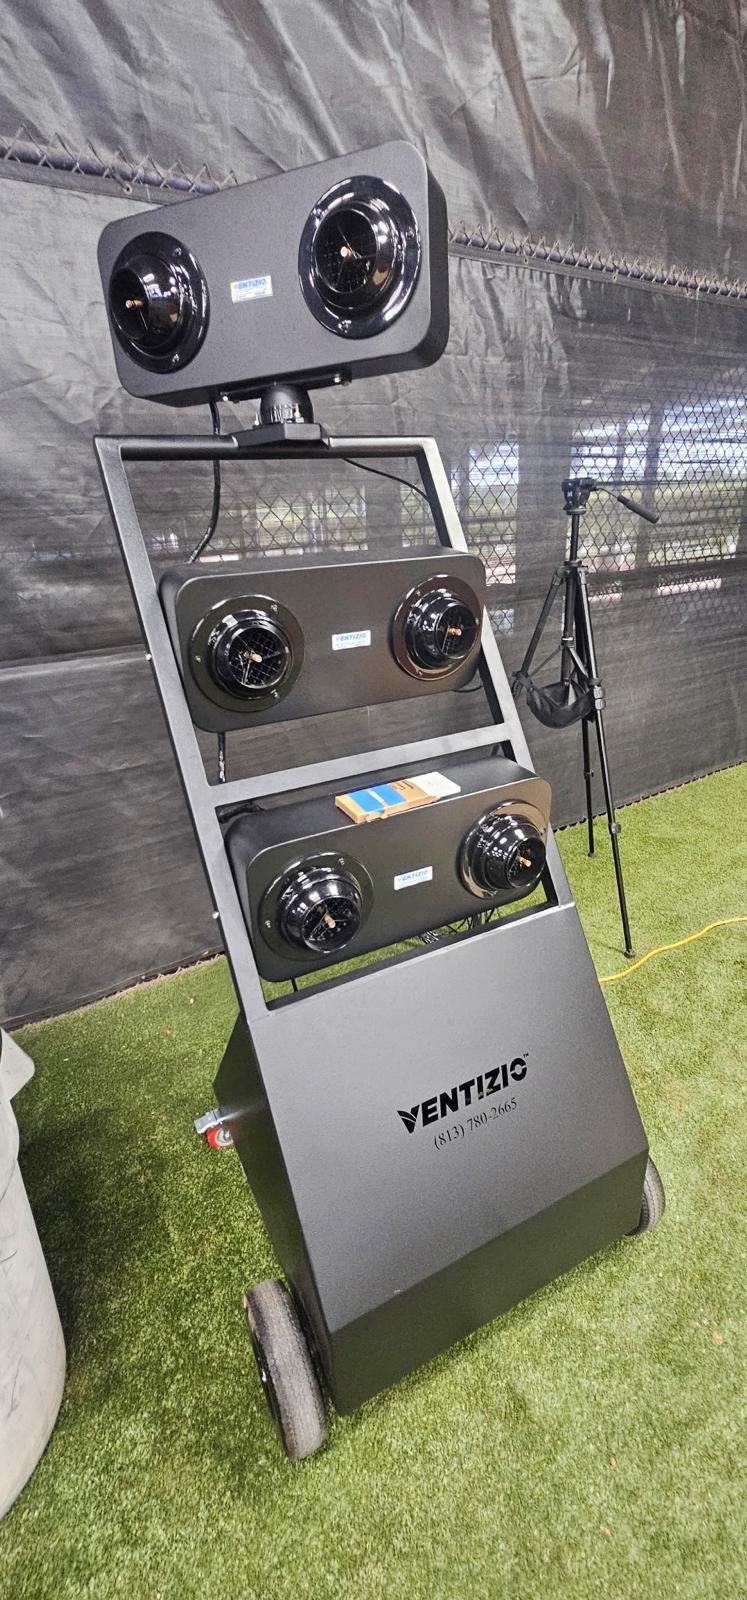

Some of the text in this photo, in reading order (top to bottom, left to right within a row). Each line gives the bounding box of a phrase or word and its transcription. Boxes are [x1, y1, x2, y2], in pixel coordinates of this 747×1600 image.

[336, 633, 367, 641] VENTIZIO
[434, 1097, 518, 1150] (813) 780-2665
